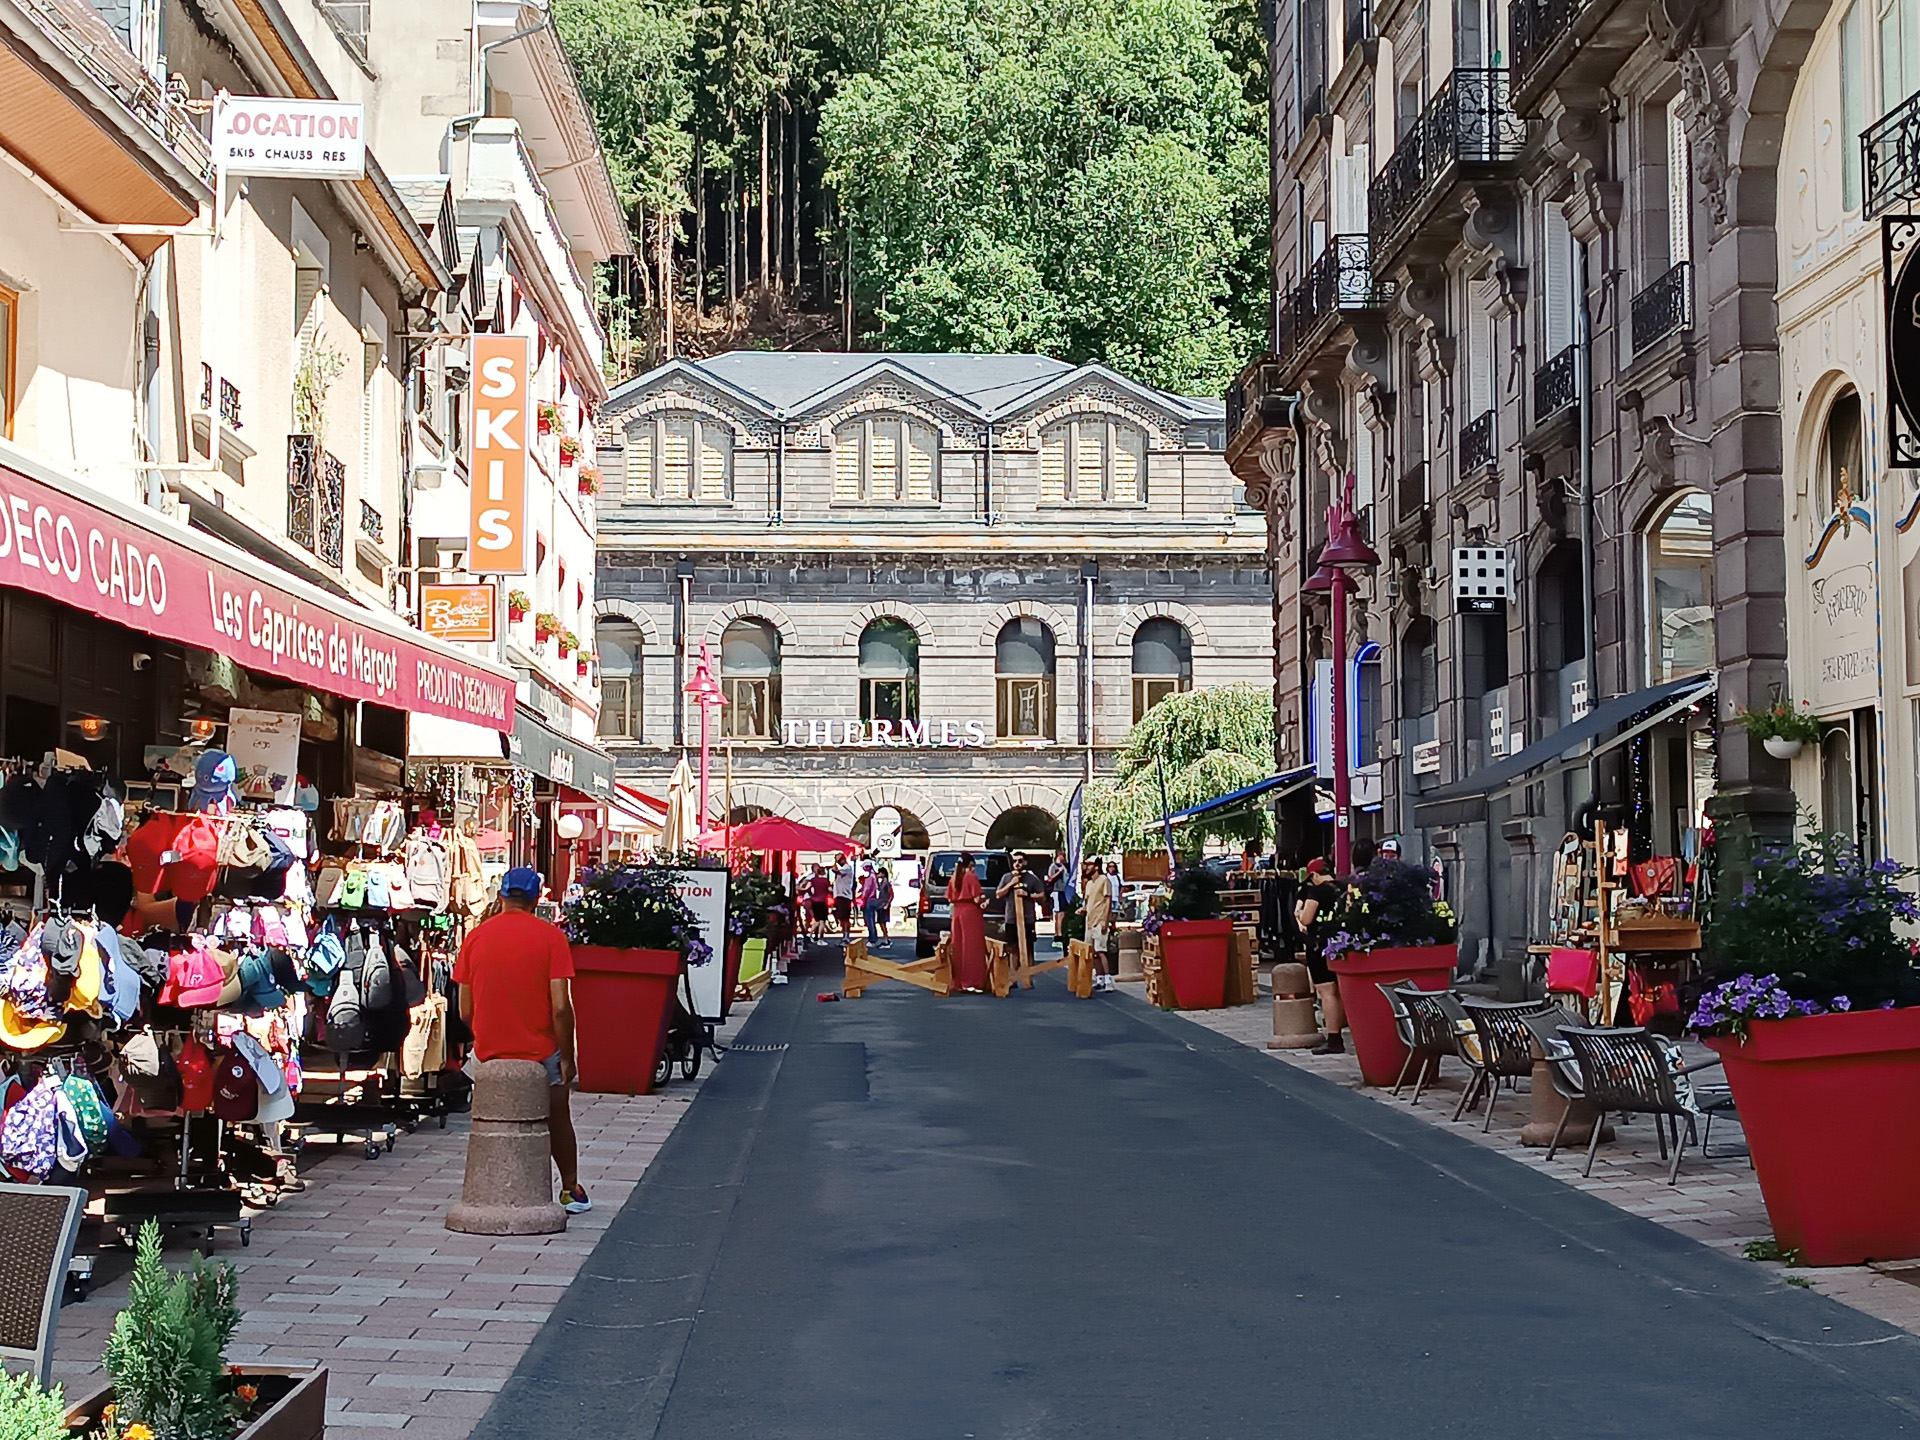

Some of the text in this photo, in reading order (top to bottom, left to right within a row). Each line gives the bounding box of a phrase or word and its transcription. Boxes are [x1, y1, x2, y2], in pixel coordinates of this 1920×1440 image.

[227, 112, 358, 139] OCATION
[229, 147, 255, 158] SKIS
[475, 356, 522, 551] SKIS
[88, 528, 167, 615] CADO
[207, 570, 398, 697] Les Caprices de Margot
[417, 660, 463, 709] PRODUITS
[464, 676, 506, 721] REGIONAUX
[782, 719, 985, 747] THERMES
